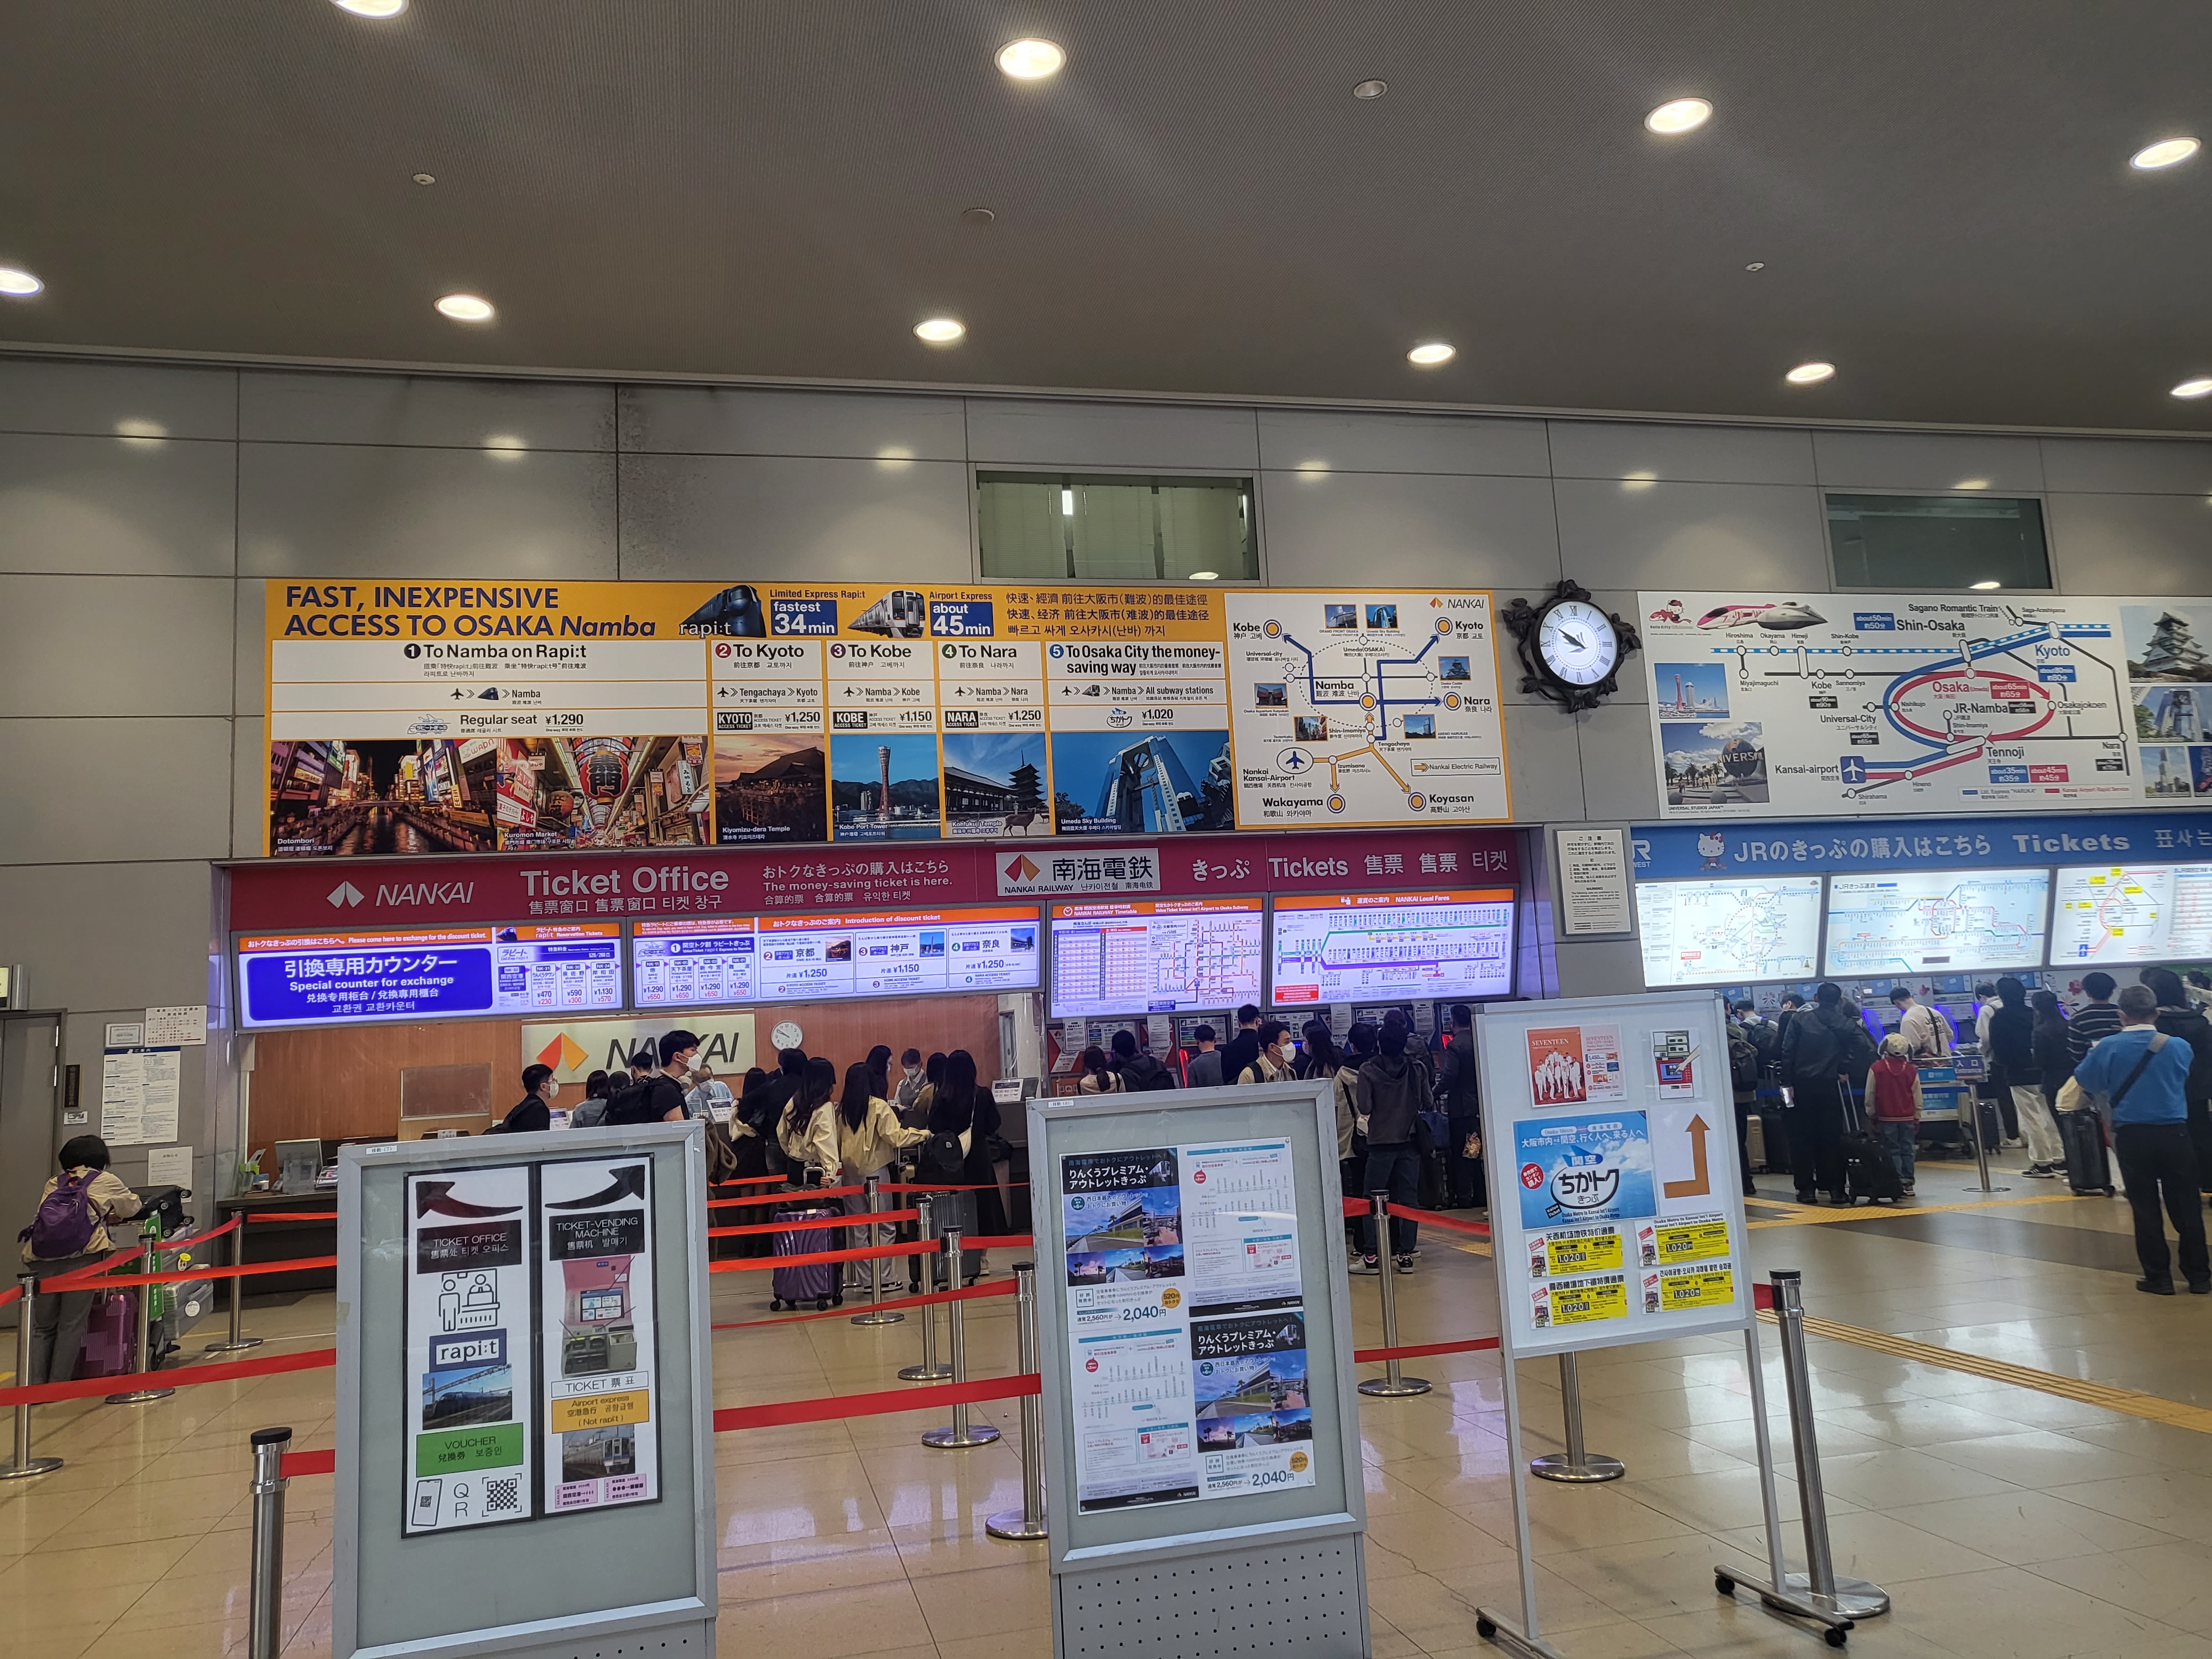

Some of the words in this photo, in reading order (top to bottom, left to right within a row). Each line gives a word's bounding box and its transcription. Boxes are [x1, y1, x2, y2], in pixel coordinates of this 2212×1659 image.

[286, 586, 364, 611] FAST,
[375, 587, 559, 608] INEXPENSIVE
[770, 589, 802, 598] Limited
[805, 590, 838, 600] Express
[930, 591, 958, 601] Airport
[961, 592, 992, 602] Express
[774, 602, 821, 612] fastest
[933, 604, 968, 614] about
[1447, 599, 1484, 608] NANKAI
[1908, 604, 1938, 613] Sagano
[1940, 604, 1977, 612] Romantic
[285, 615, 399, 636] ACCESS
[407, 615, 448, 636] TO
[454, 615, 556, 637] OSAKA
[561, 616, 656, 637] Namba
[775, 614, 806, 633] 34
[808, 623, 835, 634] min
[933, 615, 964, 634] 45
[966, 624, 991, 635] min
[1233, 623, 1260, 632] Kobe
[1455, 621, 1484, 630] Kyoto
[1897, 620, 1965, 630] Shin-Osaka
[1008, 625, 1040, 636] 빠르고
[1045, 625, 1066, 636] 싸게
[1069, 625, 1141, 637] 오사카시(난바)
[1145, 625, 1166, 637] 까지
[424, 645, 443, 658] To
[447, 645, 508, 659] Namba
[512, 648, 532, 659] on
[536, 645, 587, 662] Rapi:t
[734, 645, 754, 657] To
[757, 645, 805, 661] Kyoto
[848, 645, 868, 657] To
[871, 645, 912, 658] Kobe
[959, 645, 979, 657] To
[980, 646, 1016, 658] Nara
[1066, 645, 1081, 658] To
[1082, 645, 1122, 658] Osaka
[1125, 645, 1149, 660] City
[1151, 645, 1172, 657] the
[2035, 645, 2070, 658] Kyoto
[1067, 661, 1108, 676] saving
[1111, 664, 1136, 675] way
[1157, 687, 1183, 696] subway
[1316, 681, 1354, 690] Namba
[1933, 682, 1969, 692] Osaka
[512, 689, 541, 699] Namba
[1142, 709, 1173, 719] ¥1,020
[1954, 703, 2008, 713] JR-Namba
[460, 714, 508, 728] Regular
[512, 715, 537, 724] seat
[545, 714, 584, 727] ¥1,290
[718, 714, 751, 723] KYOTO
[785, 711, 821, 723] ¥1,250
[836, 713, 865, 723] KOBE
[900, 711, 932, 722] ¥1,150
[1820, 715, 1876, 724] Universal-City
[1986, 747, 2024, 759] Tennoji
[1775, 765, 1839, 775] Kansai-airport
[1262, 798, 1323, 808] Wakayama
[1429, 794, 1474, 804] Koyasan
[2012, 833, 2130, 853] Tickets
[1052, 856, 1152, 881] 南海電鉄
[1192, 859, 1250, 881] きっぷ
[1269, 857, 1348, 878] Tickets
[1365, 854, 1404, 875] 售票
[1420, 853, 1458, 874] 售票
[1473, 850, 1509, 872] 티켓
[520, 870, 620, 896] Ticket
[633, 866, 729, 892] Office
[764, 883, 786, 891] The
[789, 879, 871, 890] money-saving
[875, 878, 907, 888] ticket
[924, 877, 952, 885] here.
[375, 882, 474, 906] NANKAI
[893, 891, 911, 900] 티켓
[663, 896, 690, 910] 티켓
[695, 895, 722, 909] 창구
[284, 955, 457, 978] 引換専用カウンター
[290, 980, 332, 992] Special
[335, 979, 378, 989] counter
[382, 978, 398, 987] for
[400, 977, 453, 987] exchange
[1571, 1155, 1597, 1166] 関空
[1070, 1175, 1146, 1190] アウトレットきっぷ
[556, 1217, 638, 1232] TICKET-VENDING
[575, 1228, 619, 1238] MACHINE
[434, 1236, 468, 1248] TICKET
[471, 1233, 507, 1244] OFFICE
[602, 1237, 628, 1248] 발매기
[461, 1246, 479, 1256] 티켓
[482, 1244, 509, 1254] 오피스
[1123, 1306, 1166, 1322] 2,040円
[565, 1379, 607, 1392] TICKET
[611, 1378, 620, 1387] 票
[572, 1399, 598, 1407] Airport
[445, 1437, 496, 1449] VOUCHER
[476, 1447, 502, 1457] 보증인
